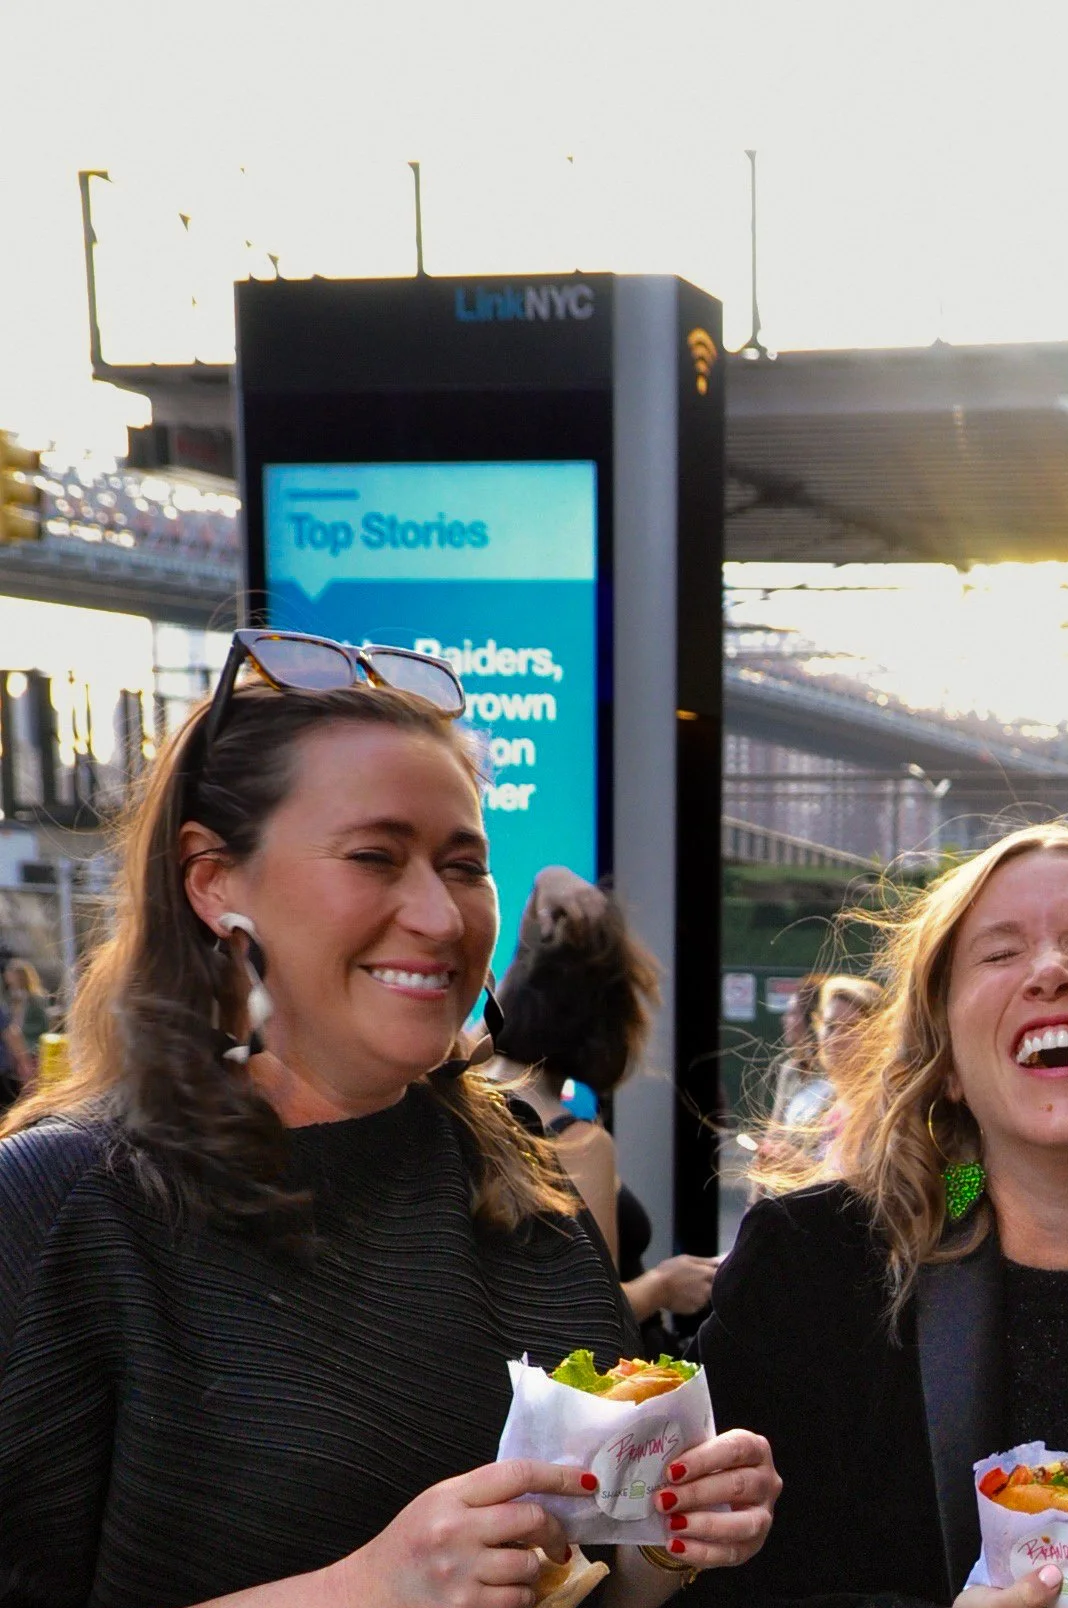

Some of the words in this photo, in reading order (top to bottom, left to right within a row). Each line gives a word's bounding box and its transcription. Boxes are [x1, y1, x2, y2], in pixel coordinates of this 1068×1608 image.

[456, 285, 594, 321] LinkNYC
[289, 512, 353, 557] Top
[361, 511, 489, 549] Stories
[464, 692, 556, 721] rown
